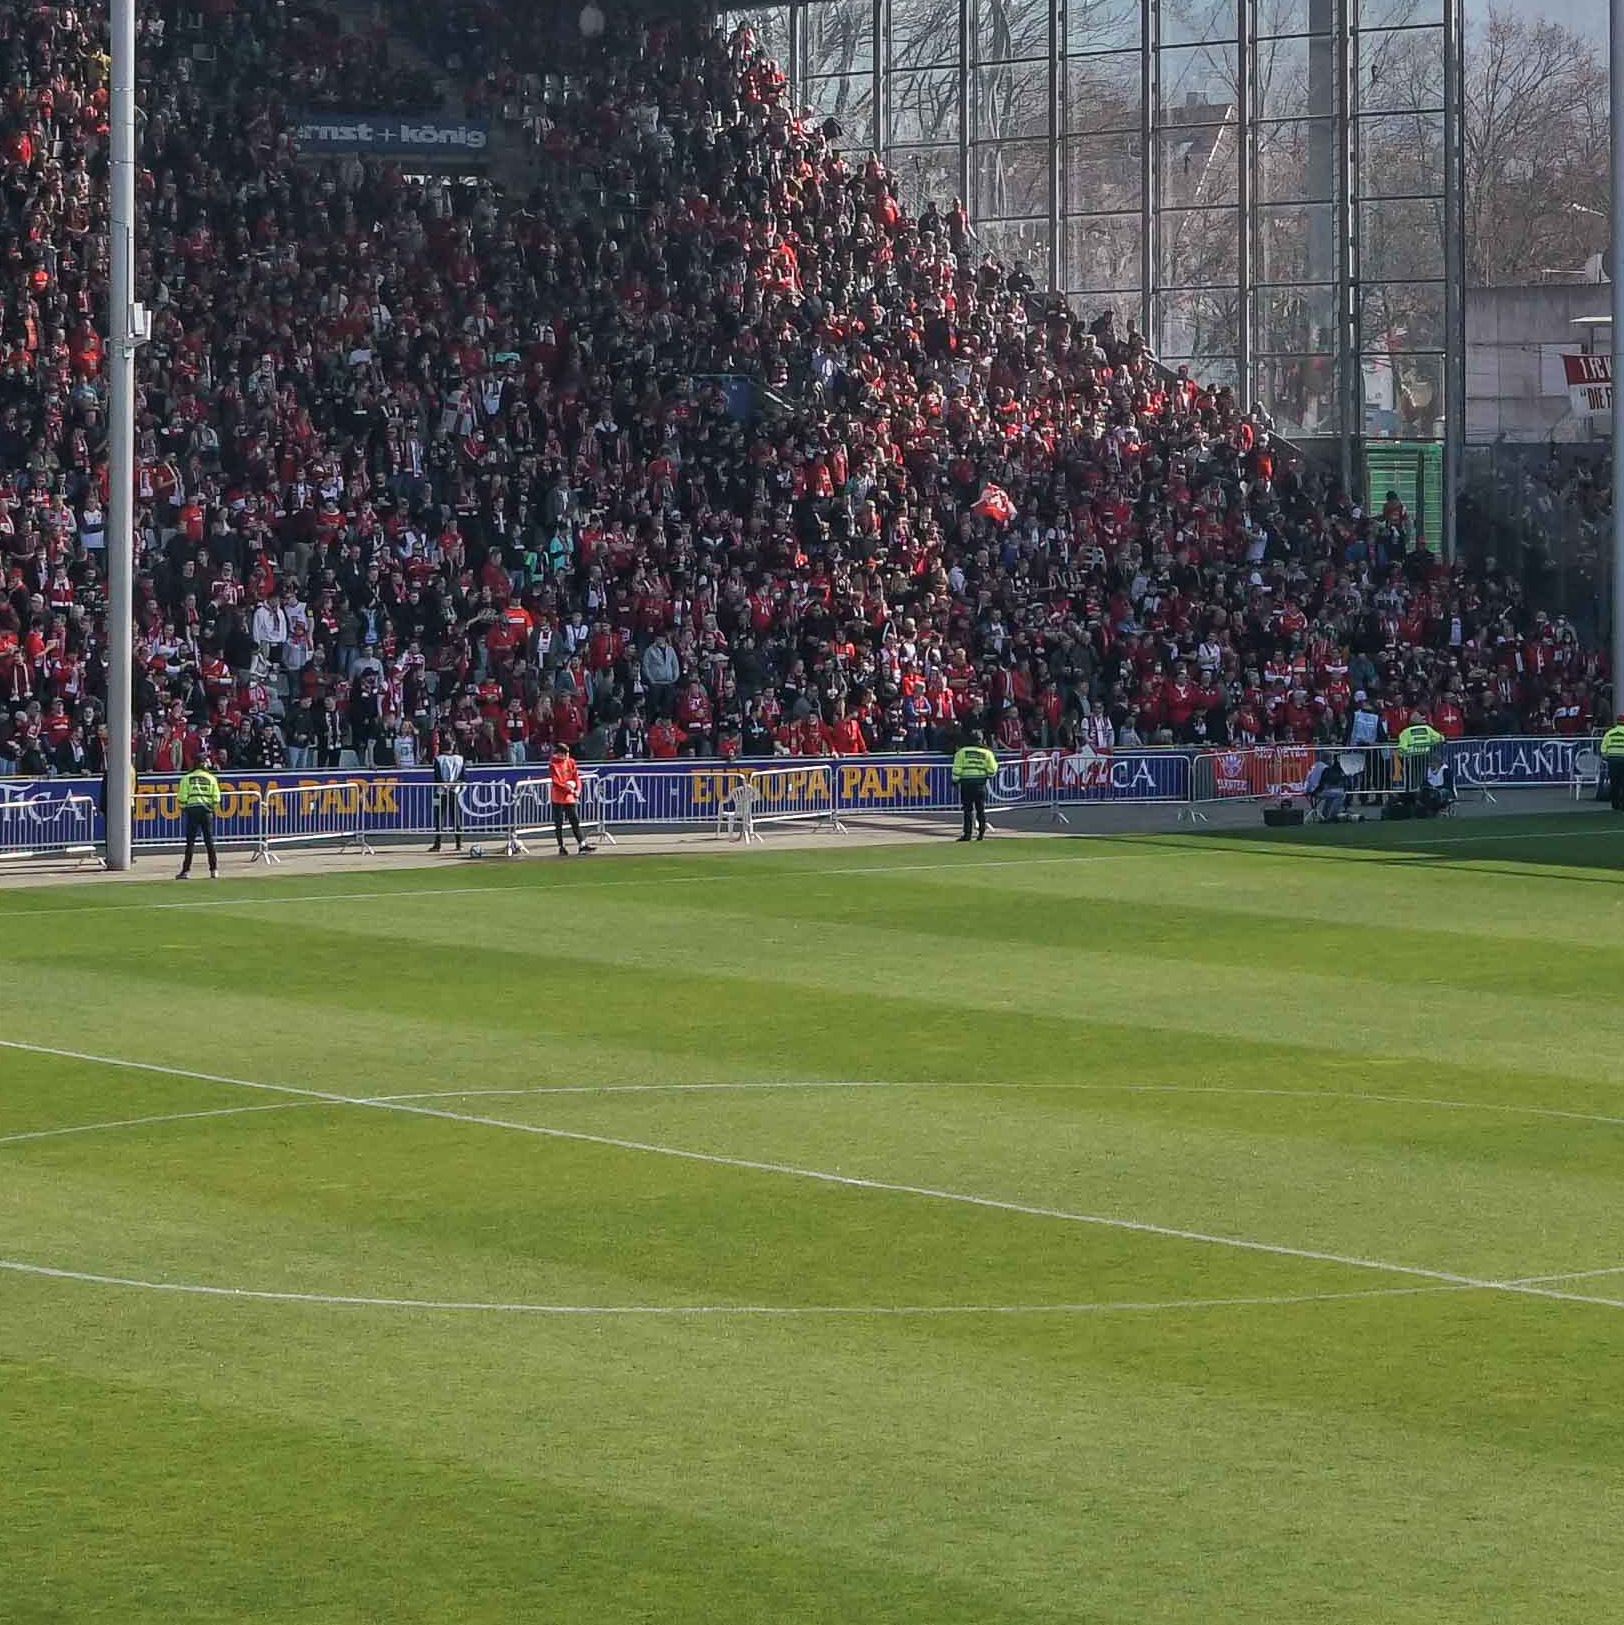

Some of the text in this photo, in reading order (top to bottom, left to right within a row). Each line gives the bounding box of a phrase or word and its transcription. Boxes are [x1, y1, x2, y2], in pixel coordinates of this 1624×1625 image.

[401, 124, 487, 148] könig
[841, 766, 932, 798] PARK
[1455, 741, 1594, 785] RULANTIC
[135, 776, 401, 820] EUOPA PARK
[456, 769, 646, 817] ULAICA
